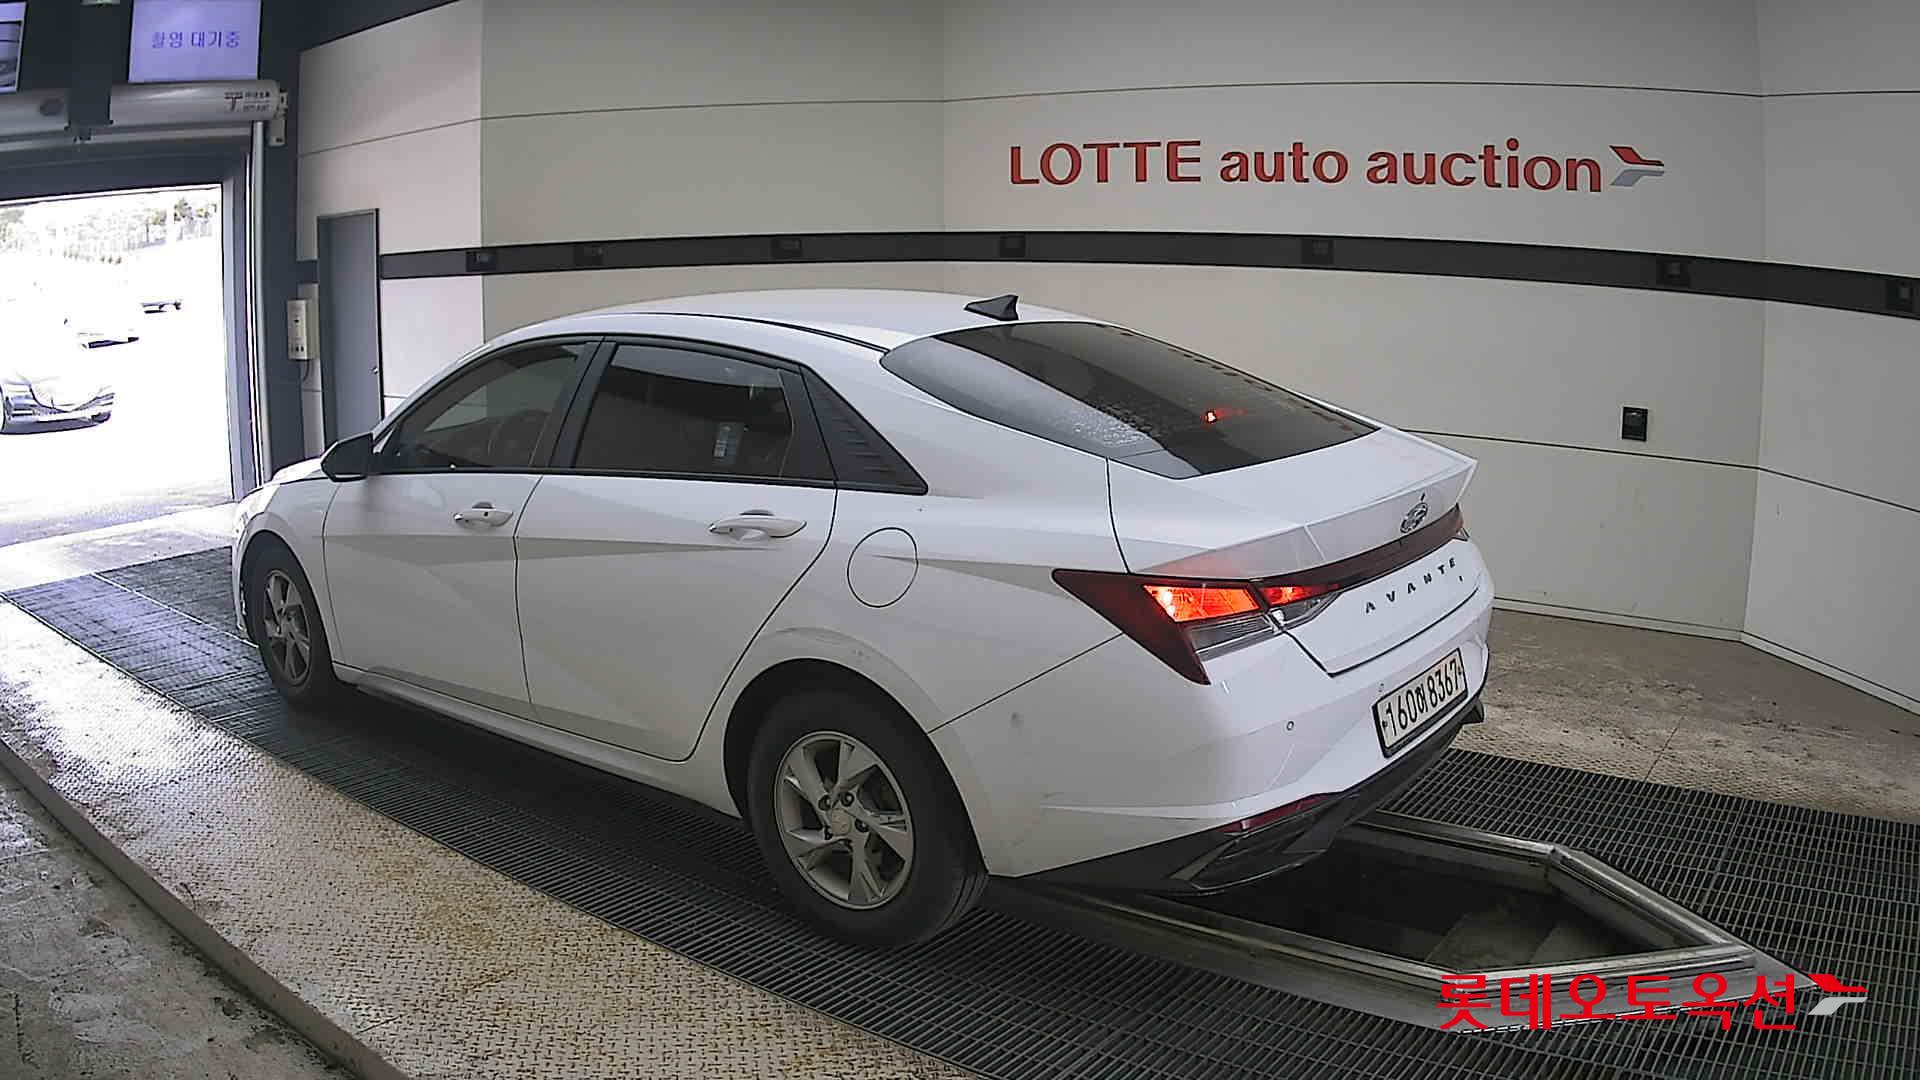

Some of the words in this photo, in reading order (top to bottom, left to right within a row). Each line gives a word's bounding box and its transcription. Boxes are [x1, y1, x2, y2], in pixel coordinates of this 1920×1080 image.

[191, 31, 240, 49] 대기중
[1010, 141, 1201, 185] LOTTE
[1220, 142, 1349, 184] auto
[1366, 138, 1602, 192] auction
[1365, 557, 1456, 614] AVANTE
